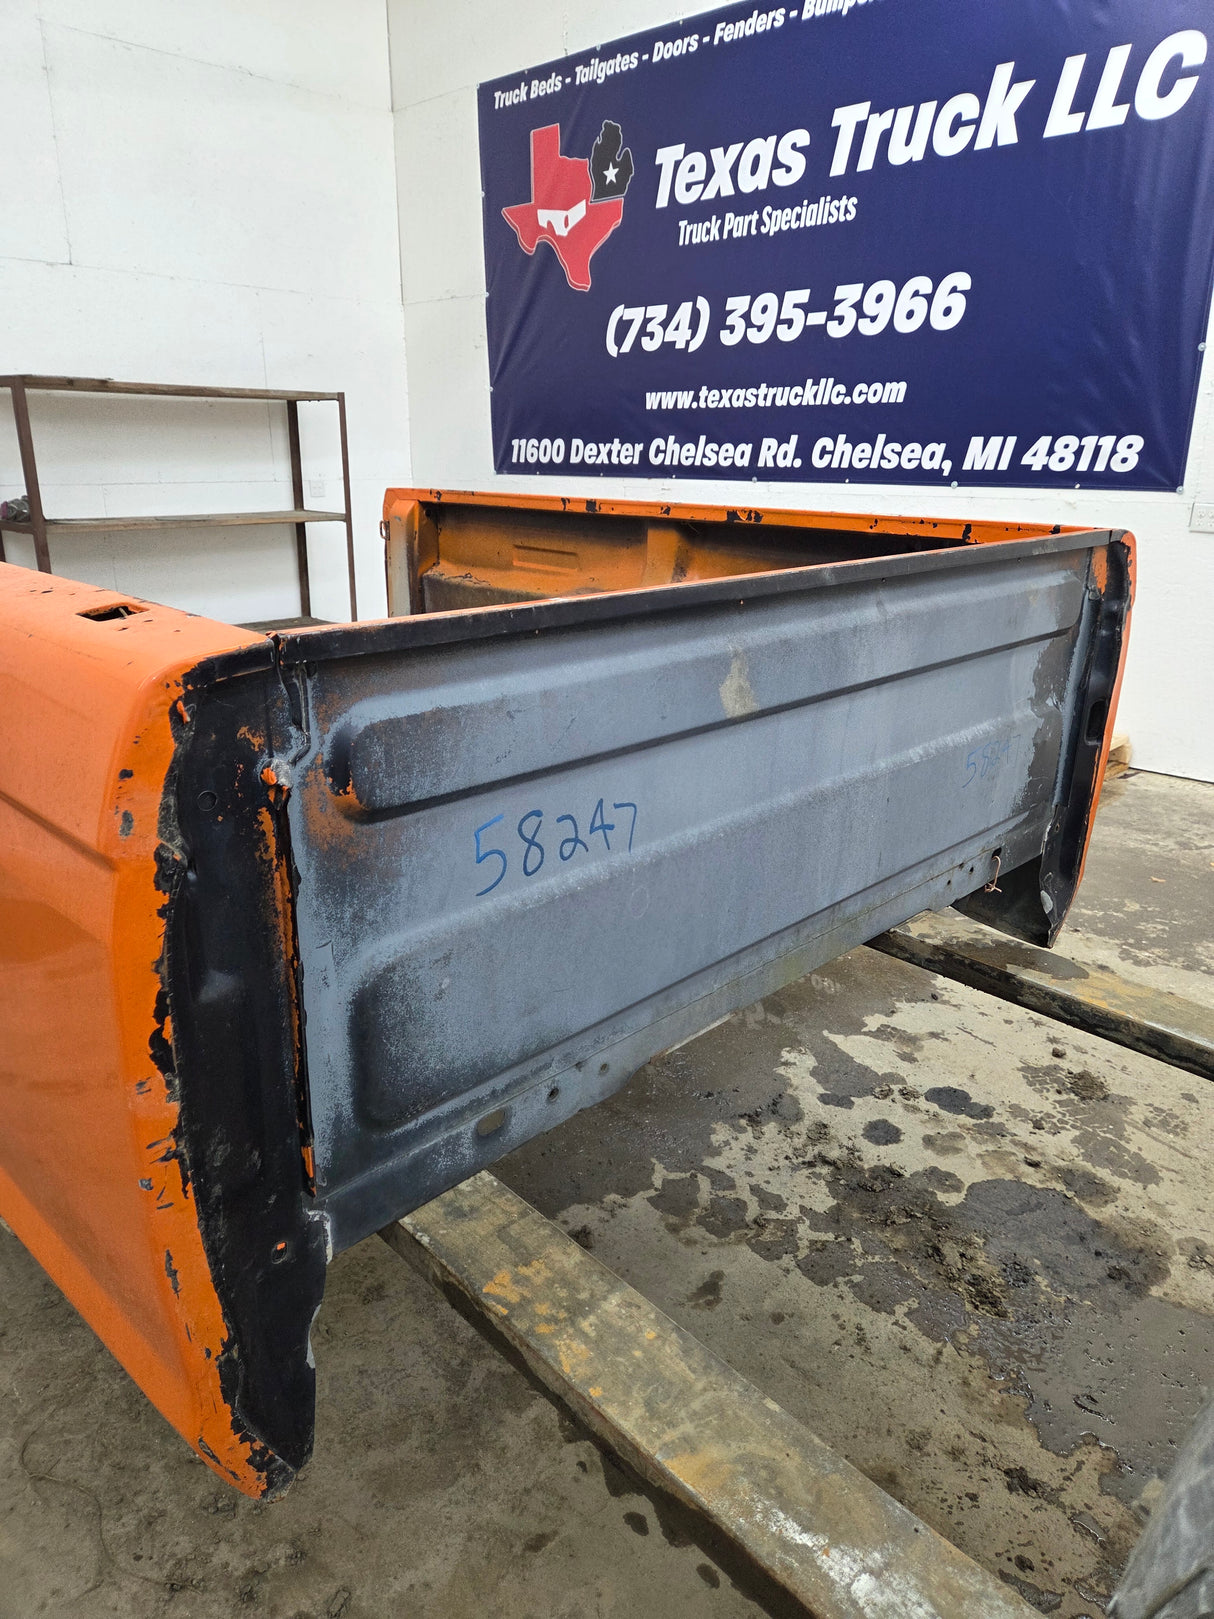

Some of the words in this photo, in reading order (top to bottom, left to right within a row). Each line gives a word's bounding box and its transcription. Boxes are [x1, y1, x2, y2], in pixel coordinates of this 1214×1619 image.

[494, 82, 528, 109] Truck
[529, 73, 563, 99] Beds
[575, 51, 638, 86] Tailgates
[652, 34, 700, 63] Doors
[713, 8, 786, 45] Fenders
[801, 0, 874, 20] Bump
[655, 129, 811, 209] Texas
[830, 61, 1036, 177] Truck
[1042, 29, 1209, 139] LLC
[679, 214, 722, 246] Truck
[723, 210, 758, 239] Part
[761, 195, 859, 237] Specialists
[605, 296, 711, 358] (734)
[719, 272, 972, 347] 395-3966
[645, 378, 907, 410] www.texastruckllc.com
[511, 438, 565, 464] 11600
[569, 438, 644, 465] Dexter
[648, 435, 752, 467] Chelsea
[757, 434, 802, 468] Rd.
[811, 434, 952, 476] Chelsea,
[961, 436, 1017, 471] MI
[1020, 435, 1145, 472] 48118
[474, 798, 637, 896] 58247
